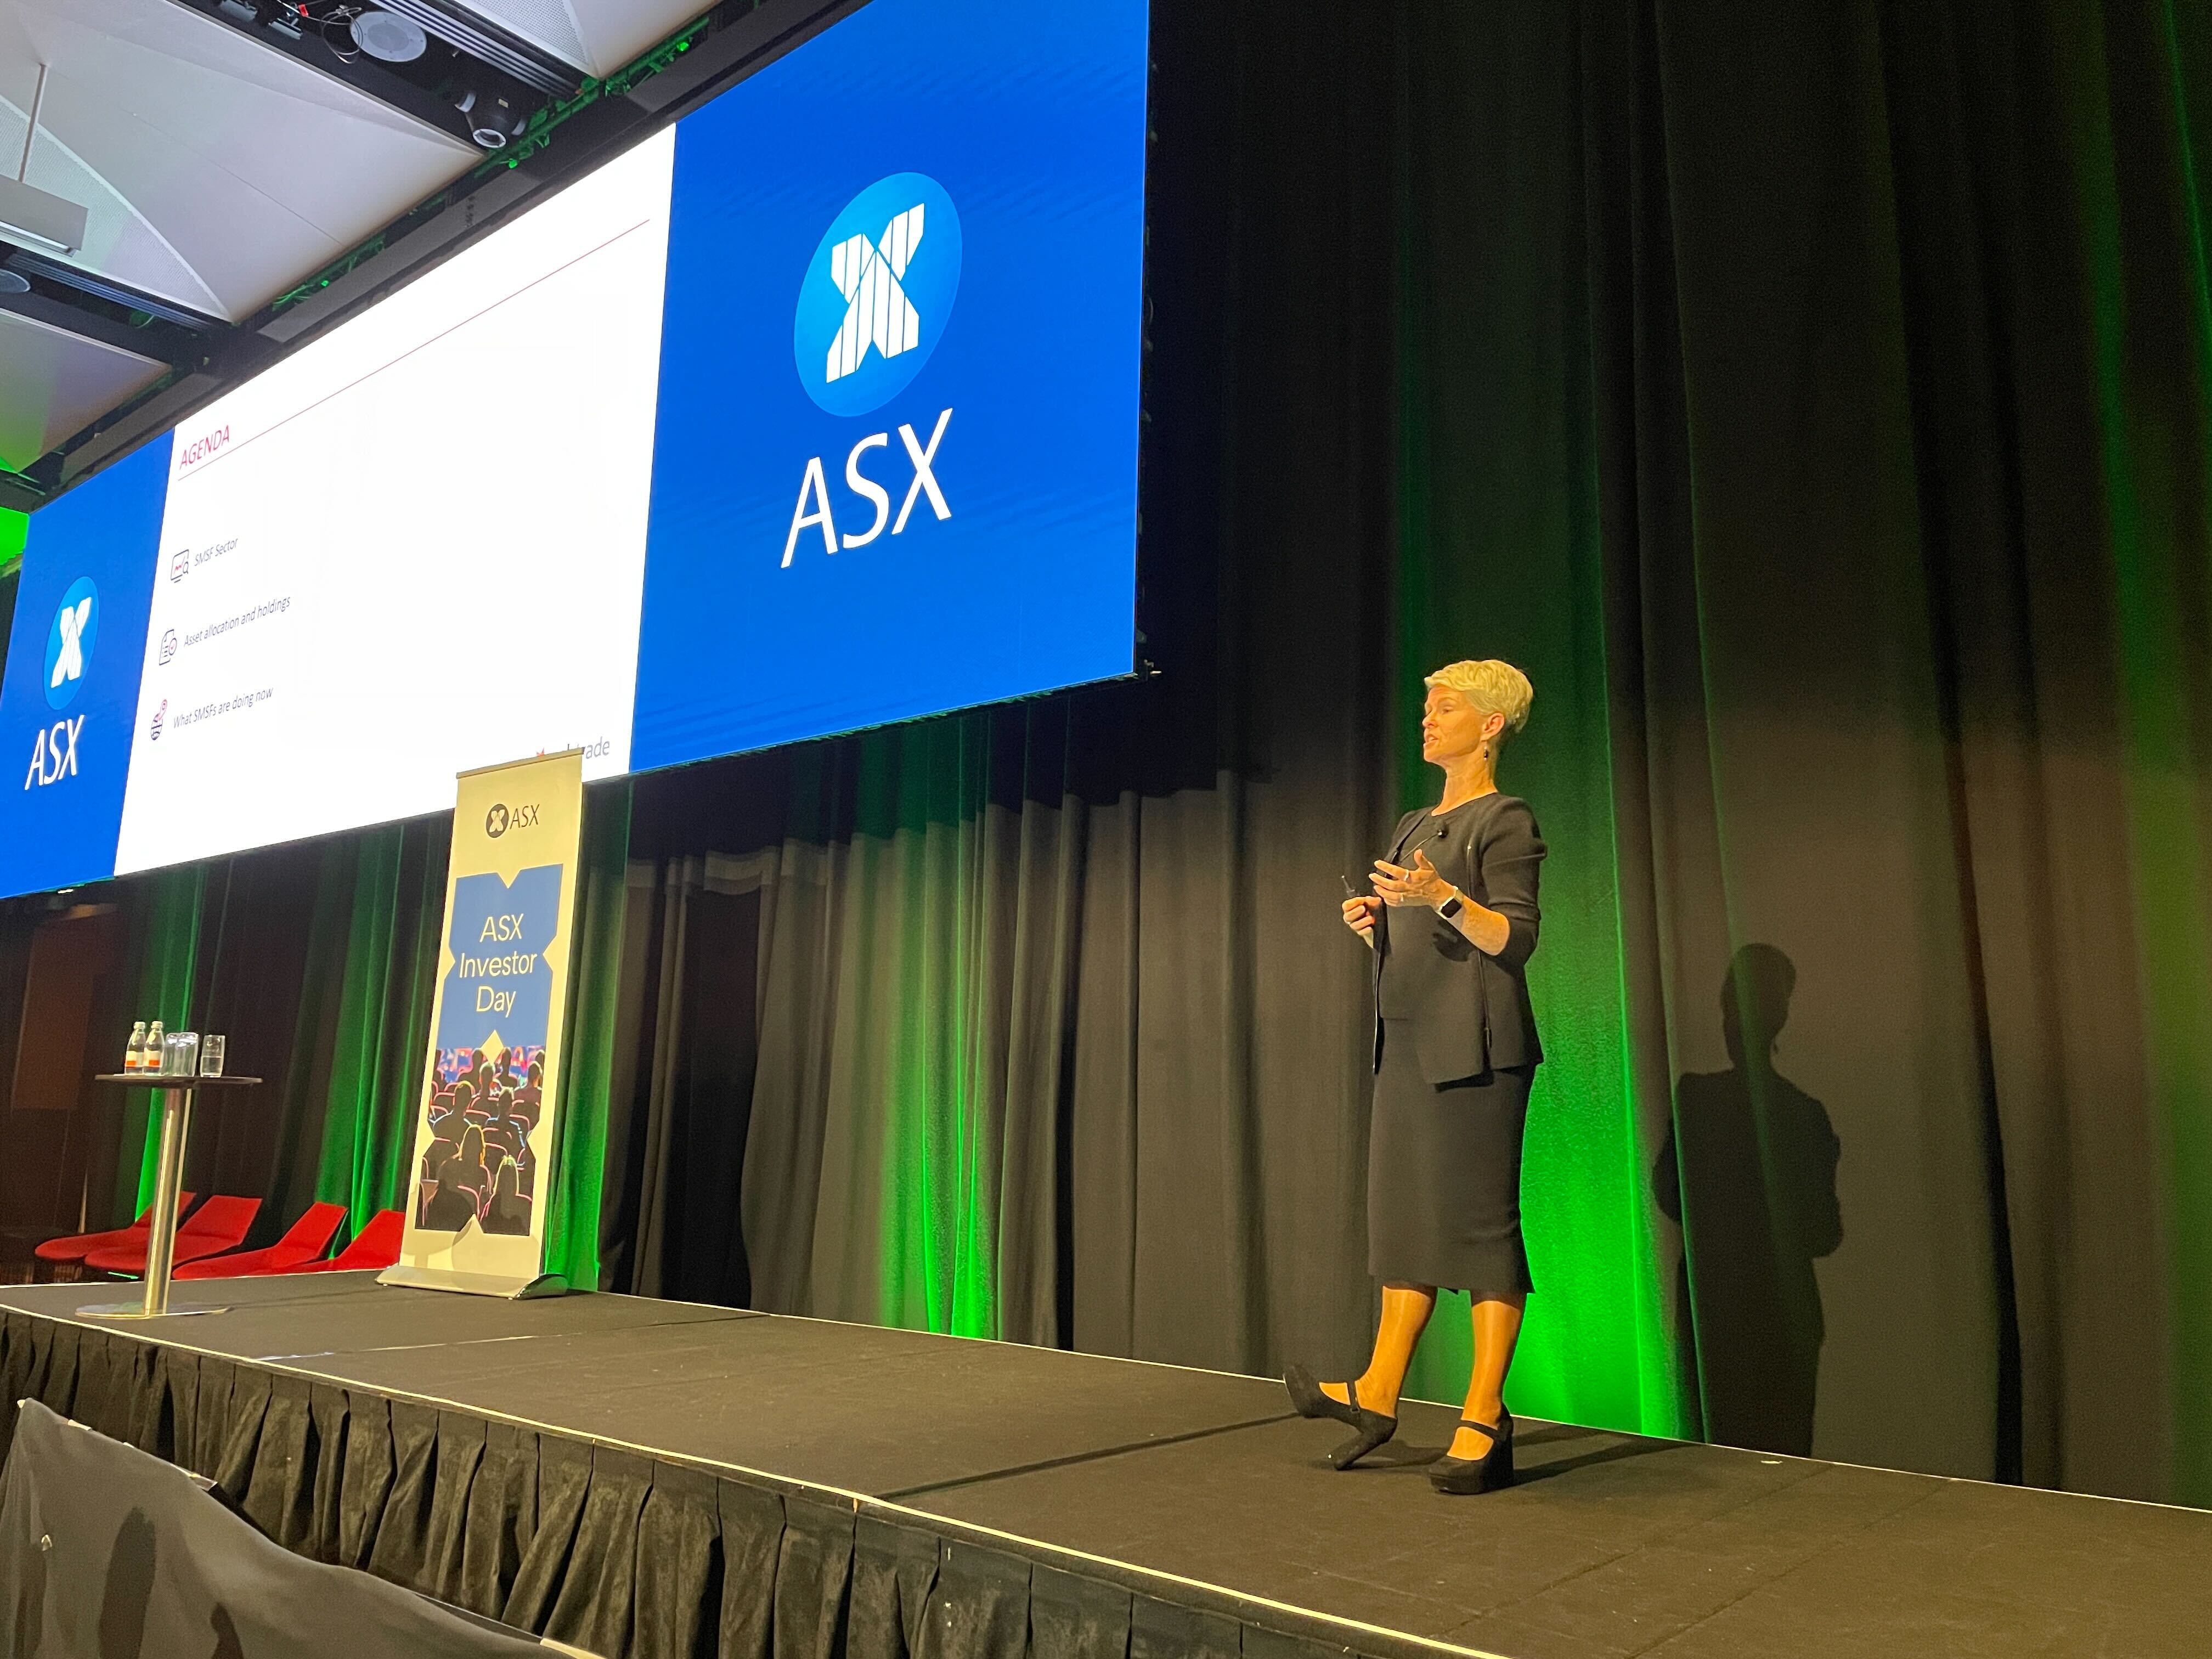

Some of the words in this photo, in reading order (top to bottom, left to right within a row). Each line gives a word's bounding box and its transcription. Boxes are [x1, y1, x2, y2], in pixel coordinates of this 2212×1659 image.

[179, 425, 229, 470] AGENDA
[781, 408, 953, 568] ASX
[194, 546, 214, 566] SMSF
[215, 538, 238, 556] Sector
[184, 631, 202, 647] Asset
[204, 617, 239, 639] allocation
[241, 607, 256, 624] and
[257, 597, 290, 618] holdings
[174, 713, 192, 729] What
[194, 704, 217, 723] SMSFs
[218, 702, 230, 714] are
[233, 694, 254, 709] doing
[256, 687, 274, 702] now
[25, 714, 84, 790] ASX
[510, 804, 539, 830] ASX
[479, 913, 524, 943] ASX
[459, 951, 537, 978] Investor
[476, 986, 516, 1018] Day
